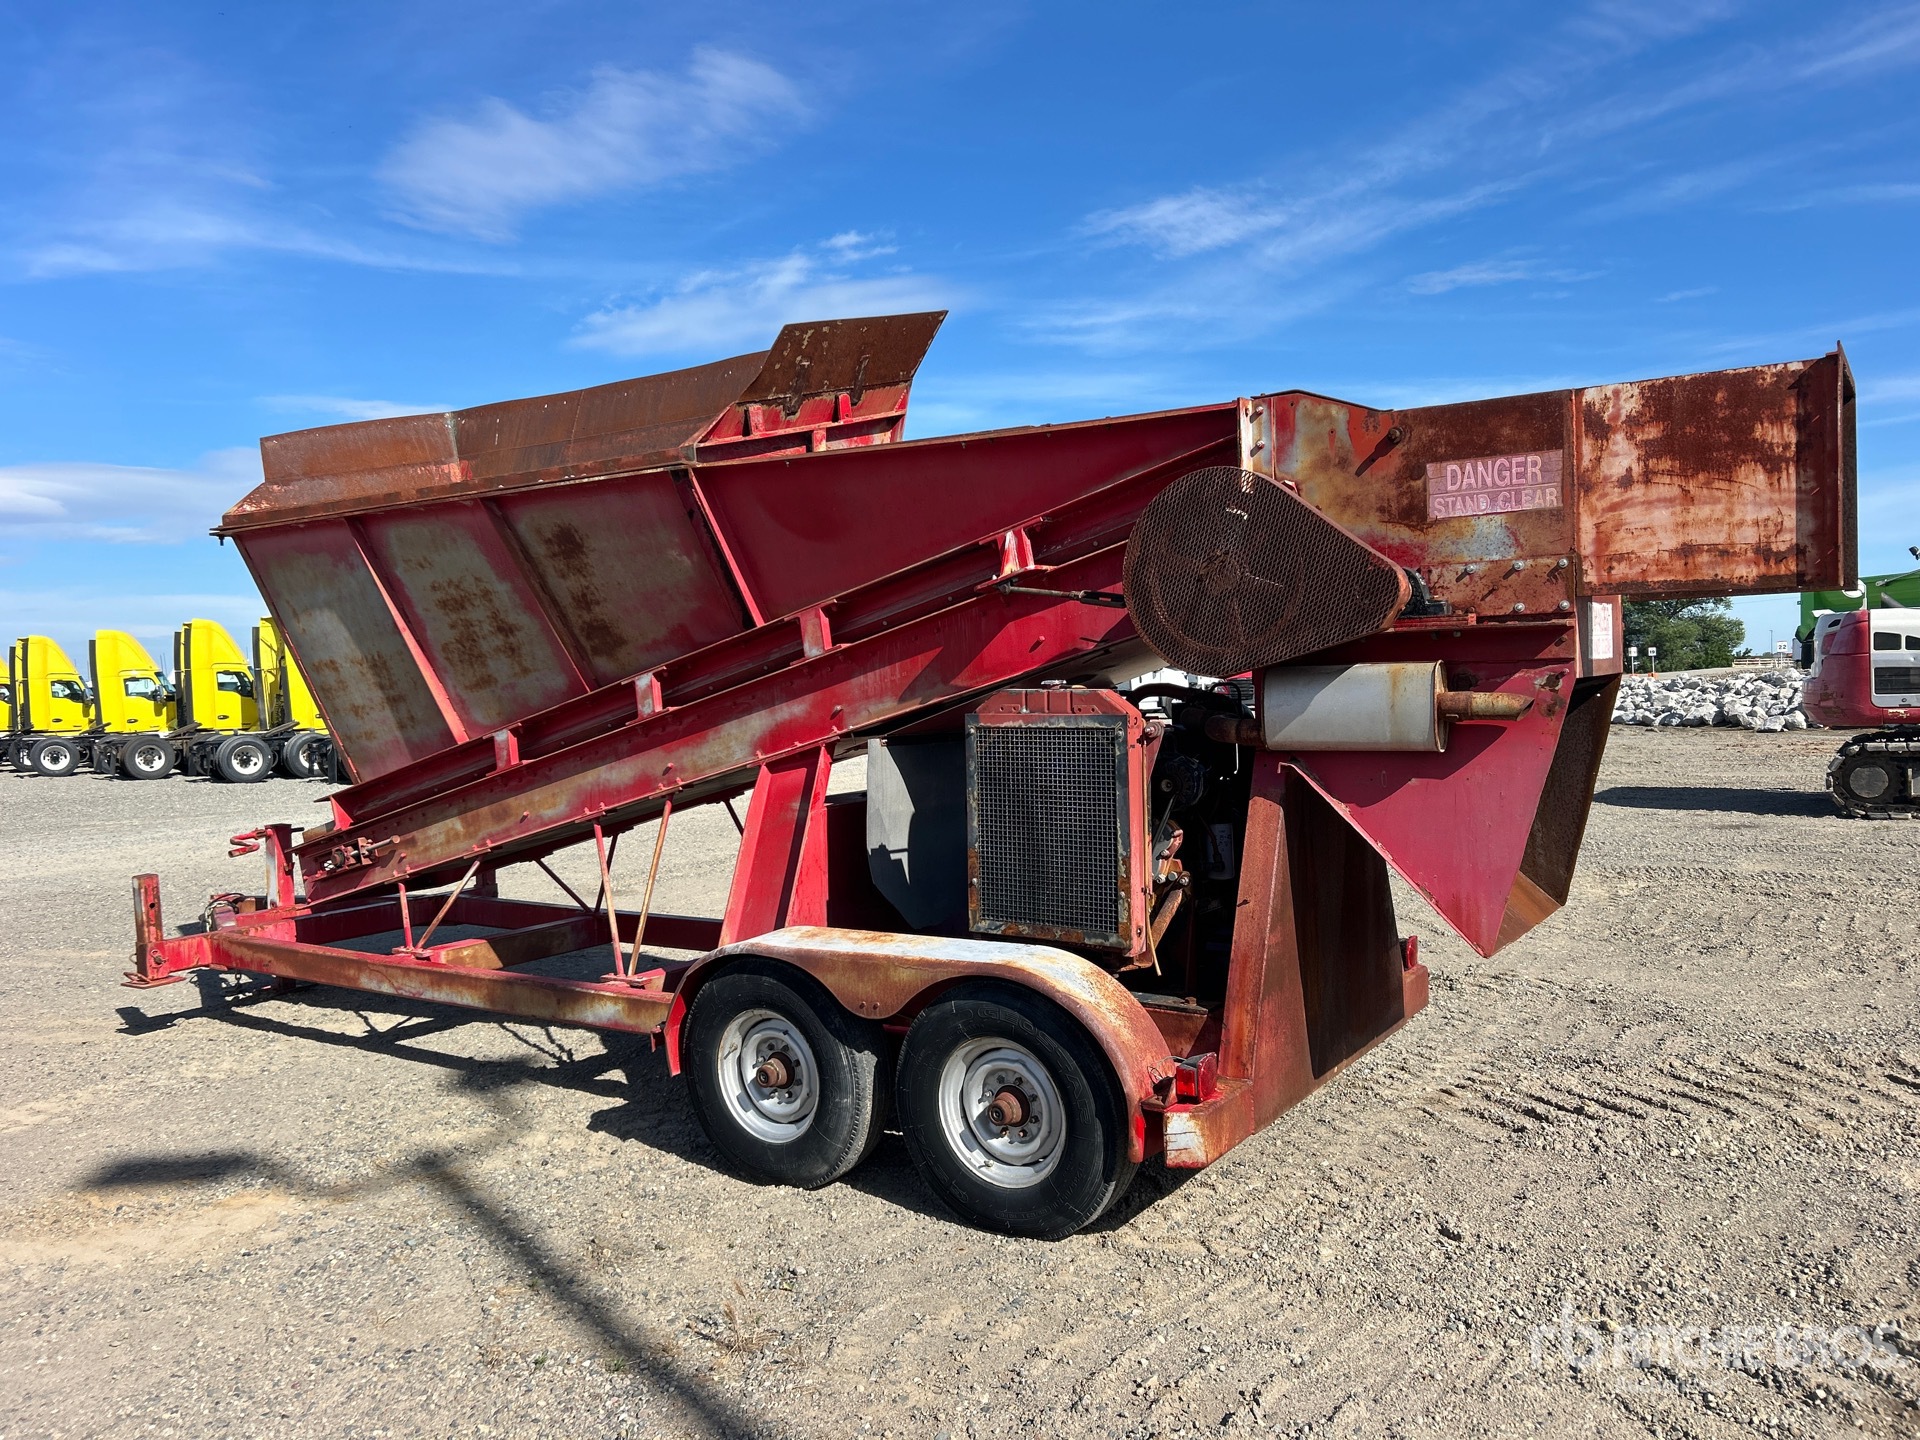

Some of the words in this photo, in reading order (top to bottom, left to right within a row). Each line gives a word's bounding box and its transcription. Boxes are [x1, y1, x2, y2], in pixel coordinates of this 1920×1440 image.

[1446, 455, 1542, 491] DANGER
[1433, 493, 1490, 518] STAND
[1497, 487, 1558, 512] CLEAR
[977, 1006, 1092, 1125] GEOSTAR
